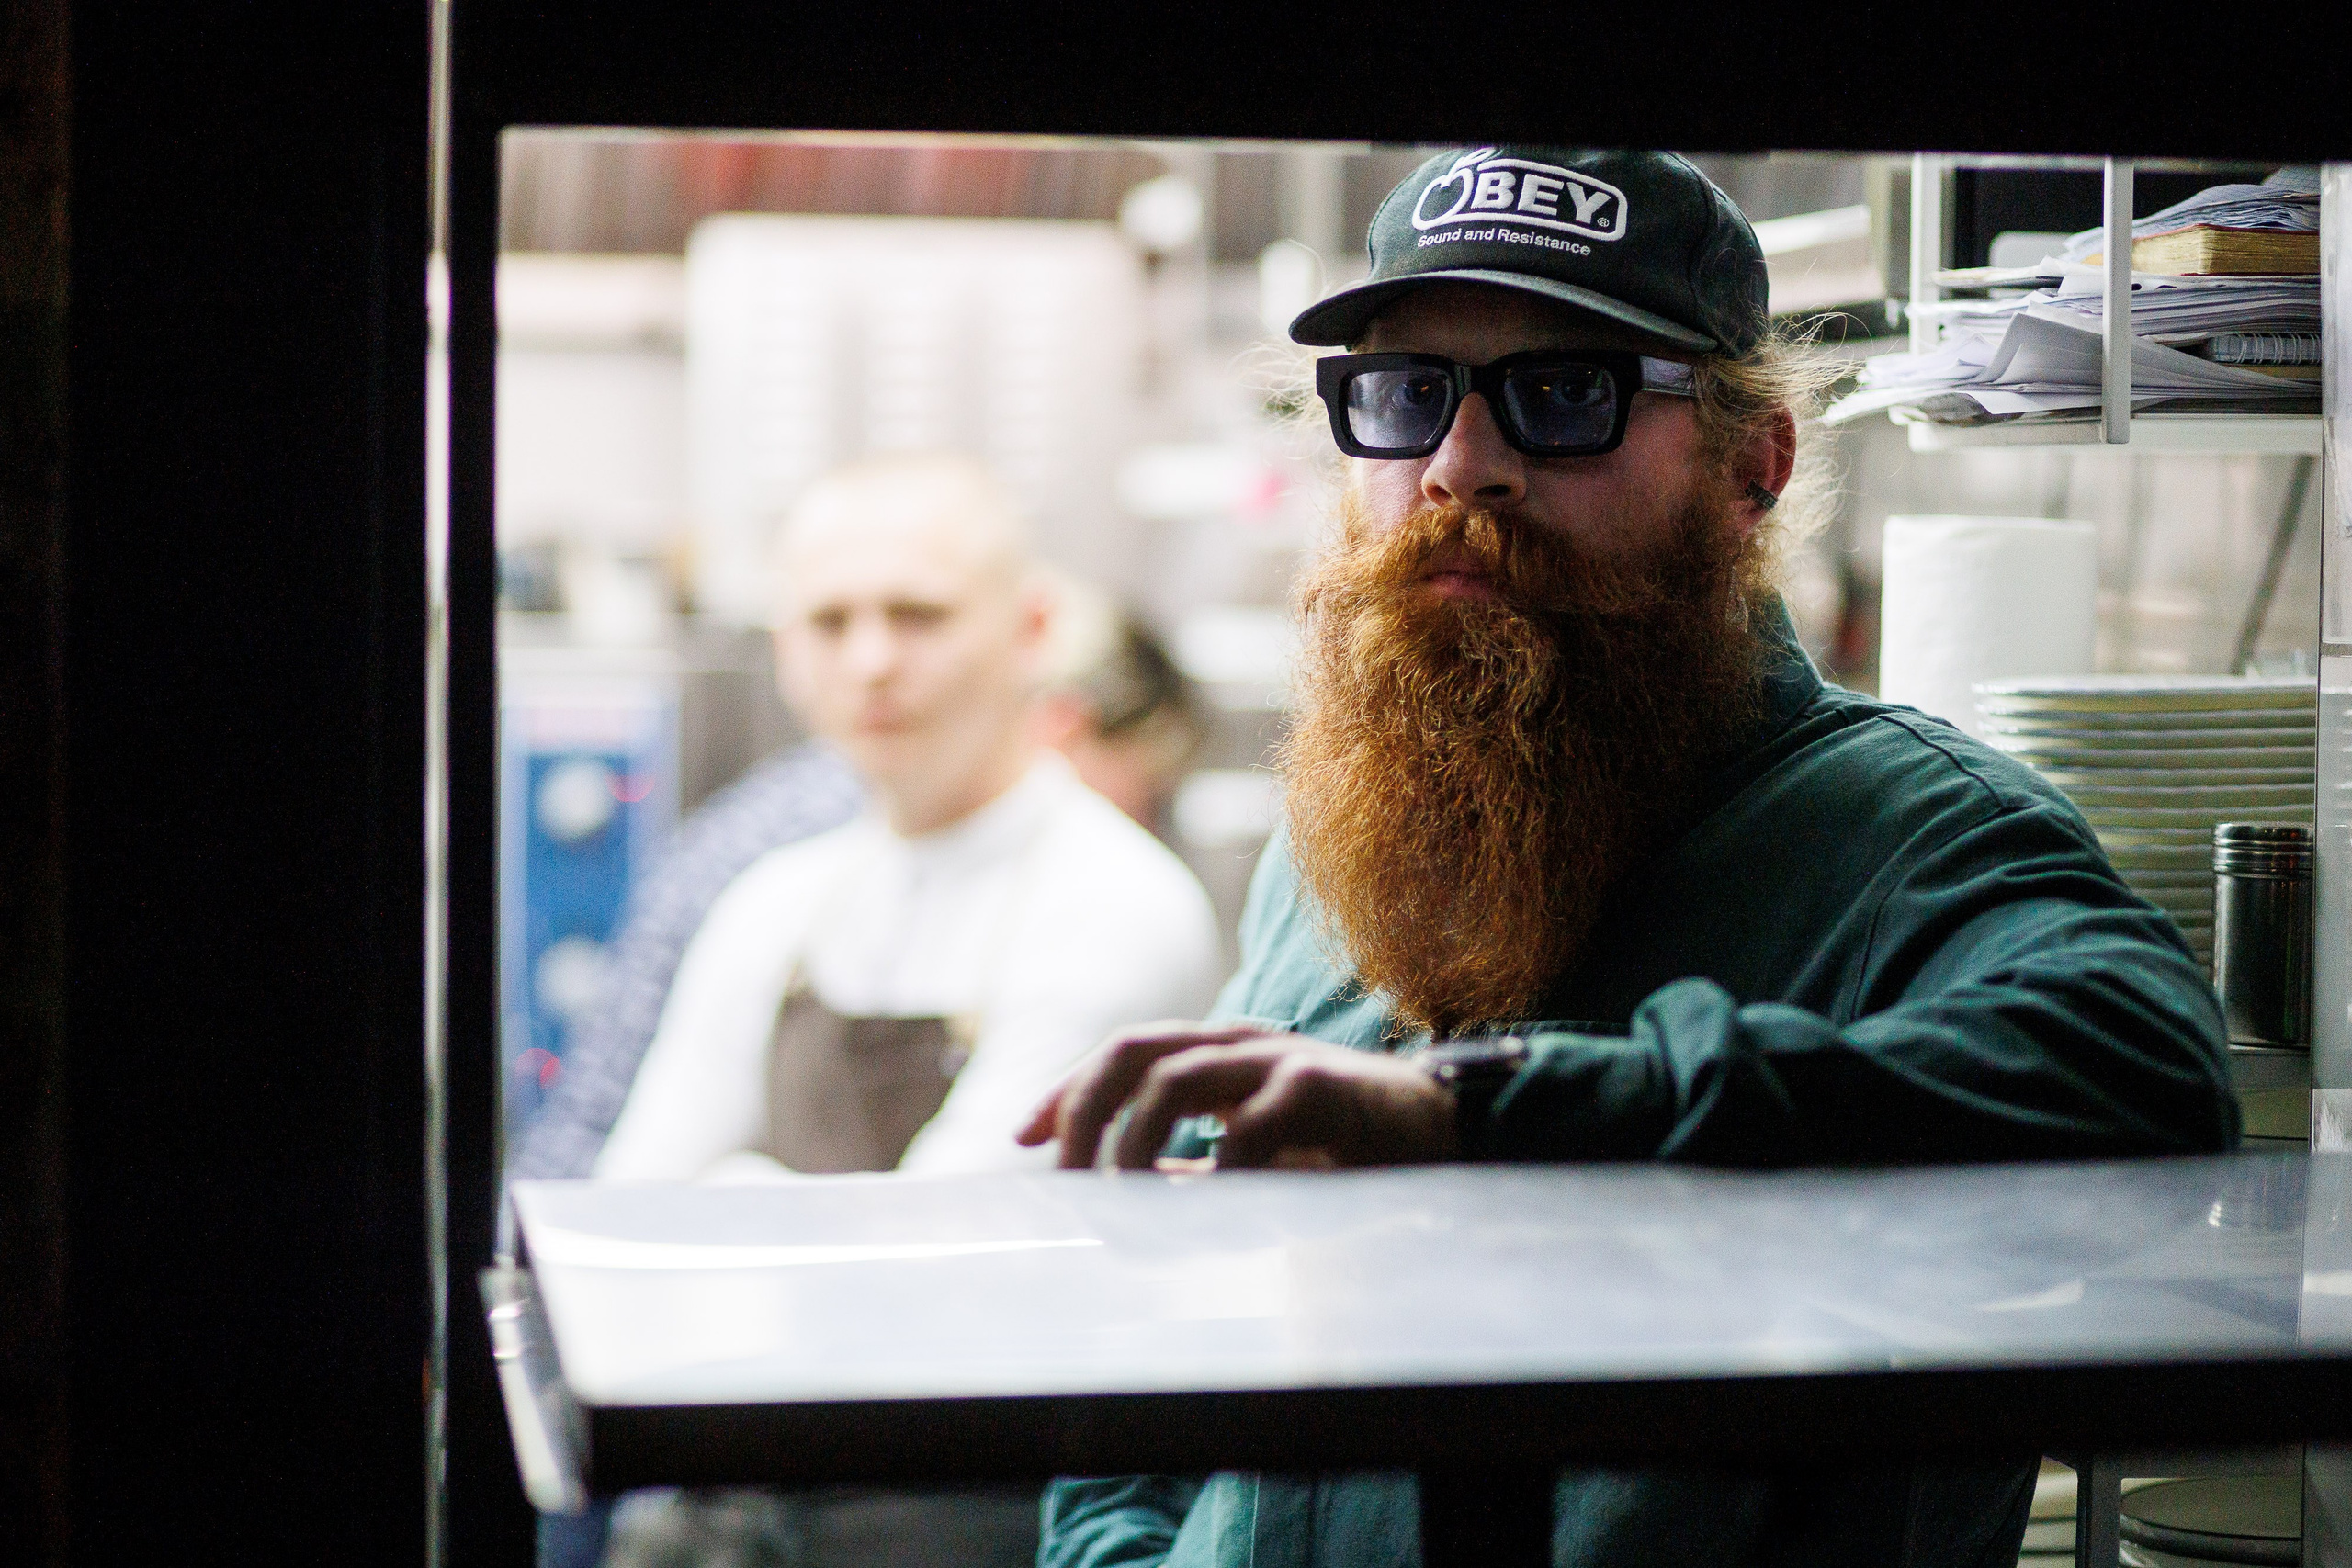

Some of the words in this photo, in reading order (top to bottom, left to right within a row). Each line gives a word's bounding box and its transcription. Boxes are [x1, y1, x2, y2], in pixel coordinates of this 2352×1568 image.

[1417, 228, 1463, 248] Sound
[1464, 228, 1495, 242] and
[1498, 230, 1591, 256] Resistance
